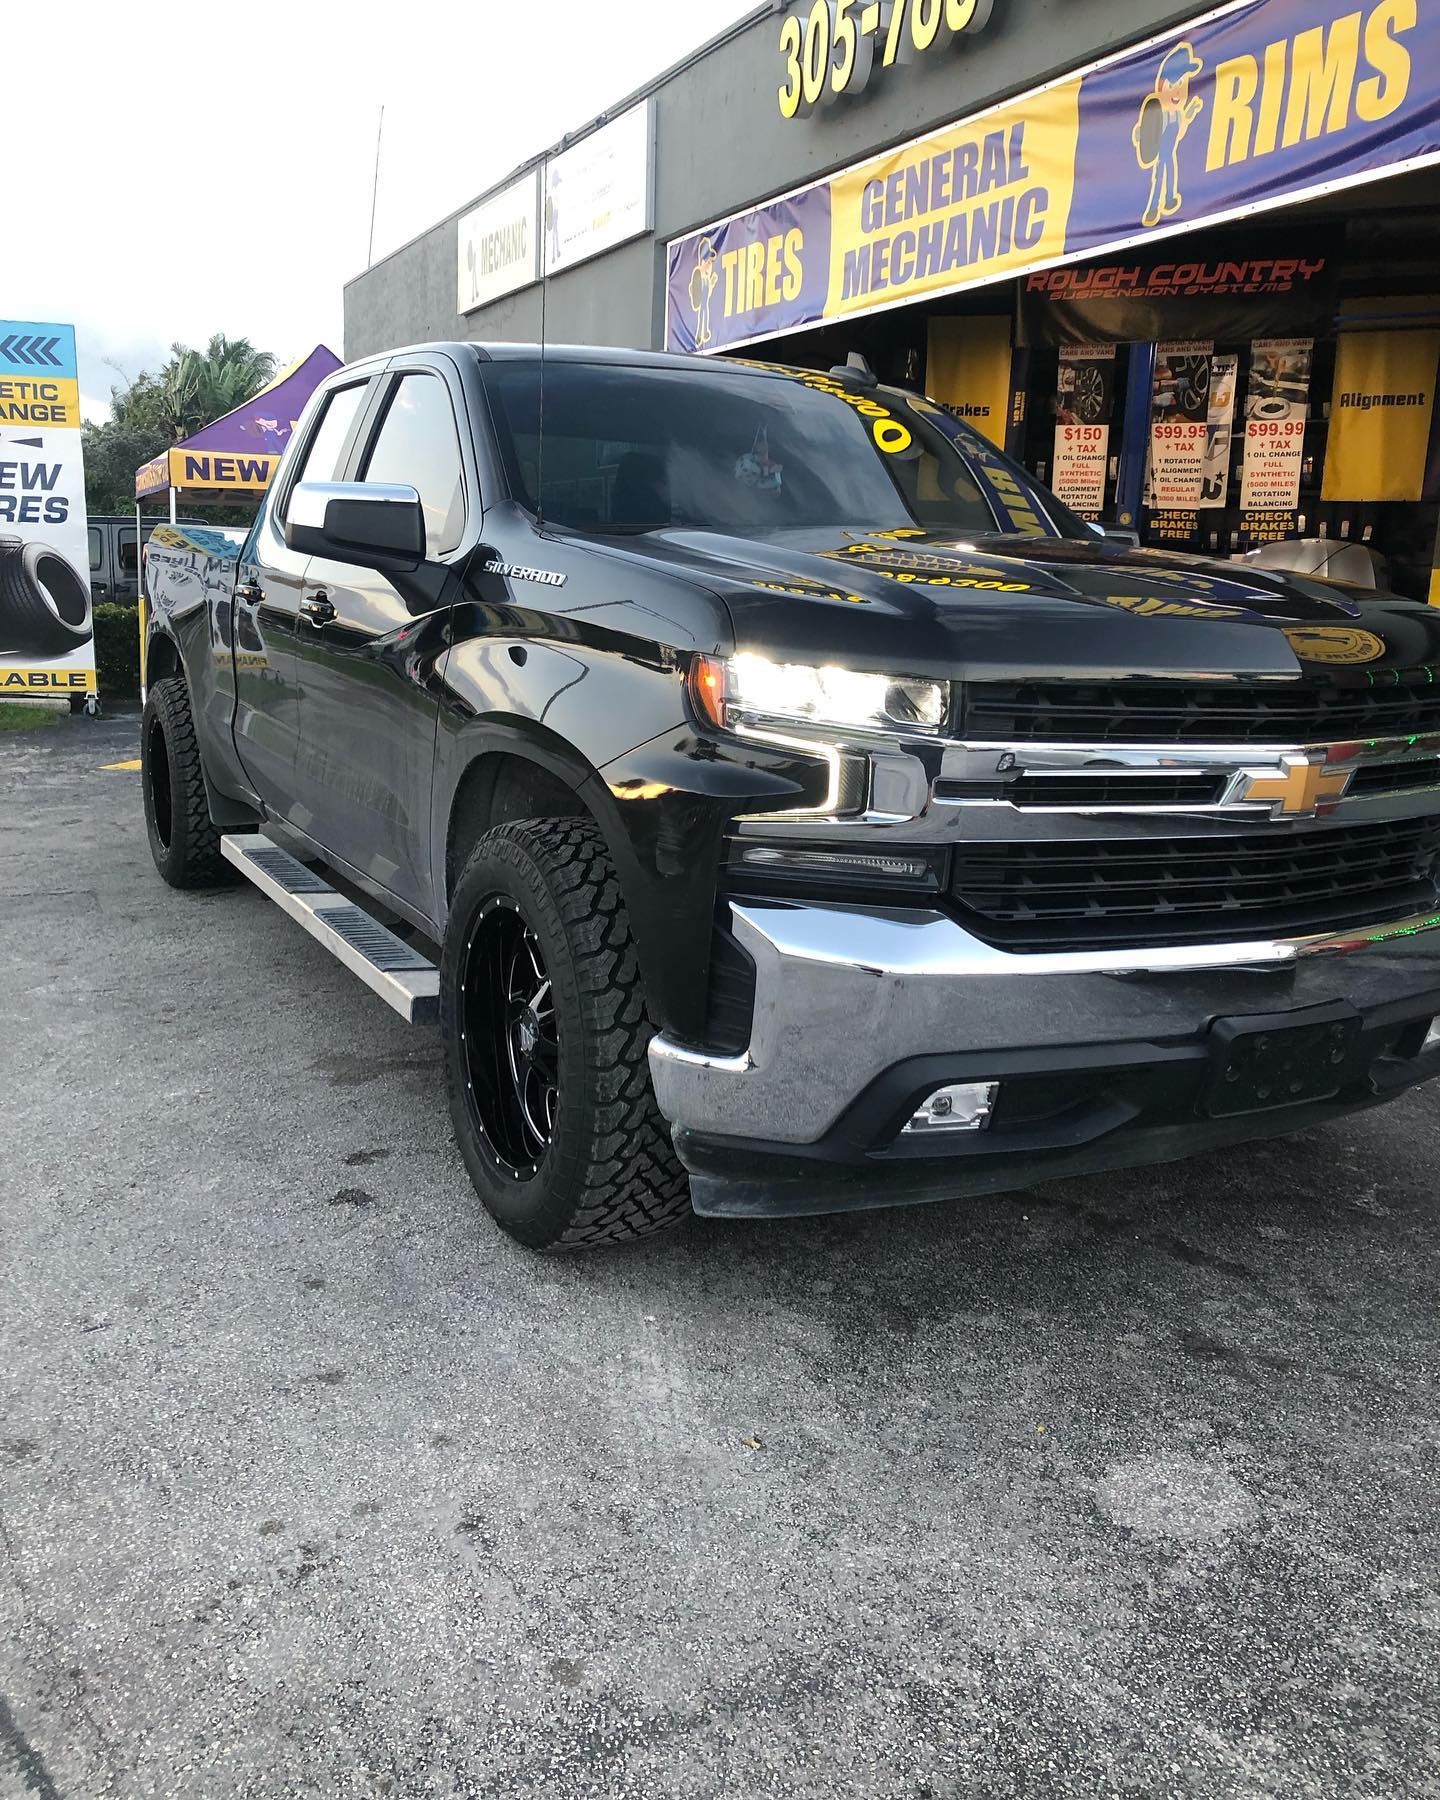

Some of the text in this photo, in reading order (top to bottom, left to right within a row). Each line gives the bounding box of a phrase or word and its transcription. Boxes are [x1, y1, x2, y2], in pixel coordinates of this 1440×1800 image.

[1206, 0, 1417, 172] RIMS
[861, 121, 1029, 233] GENERAL
[481, 216, 527, 276] MECHANIC
[841, 186, 1048, 300] MECHANIC
[721, 228, 803, 318] TIRES
[1026, 258, 1325, 292] ROUGH COUNTRY
[1049, 282, 1293, 301] SUSPENSION SYSTEMS
[0, 381, 59, 401] ETIC
[1340, 393, 1425, 410] Alignment
[1064, 427, 1102, 441] $150
[1154, 425, 1207, 439] $99.95
[1248, 422, 1304, 438] $99.99
[1174, 443, 1195, 451] TAX
[1269, 441, 1291, 449] TAX
[0, 461, 63, 490] EW
[185, 456, 270, 482] NEW
[0, 495, 69, 524] RES
[1156, 511, 1197, 520] CHECK
[1245, 512, 1292, 521] CHECK
[1150, 520, 1198, 529] BRAKES
[1240, 521, 1295, 531] BRAKES
[1160, 530, 1191, 539] FREE
[1250, 531, 1286, 540] FREE
[482, 560, 568, 587] SILVERADO
[0, 672, 87, 686] ABLE
